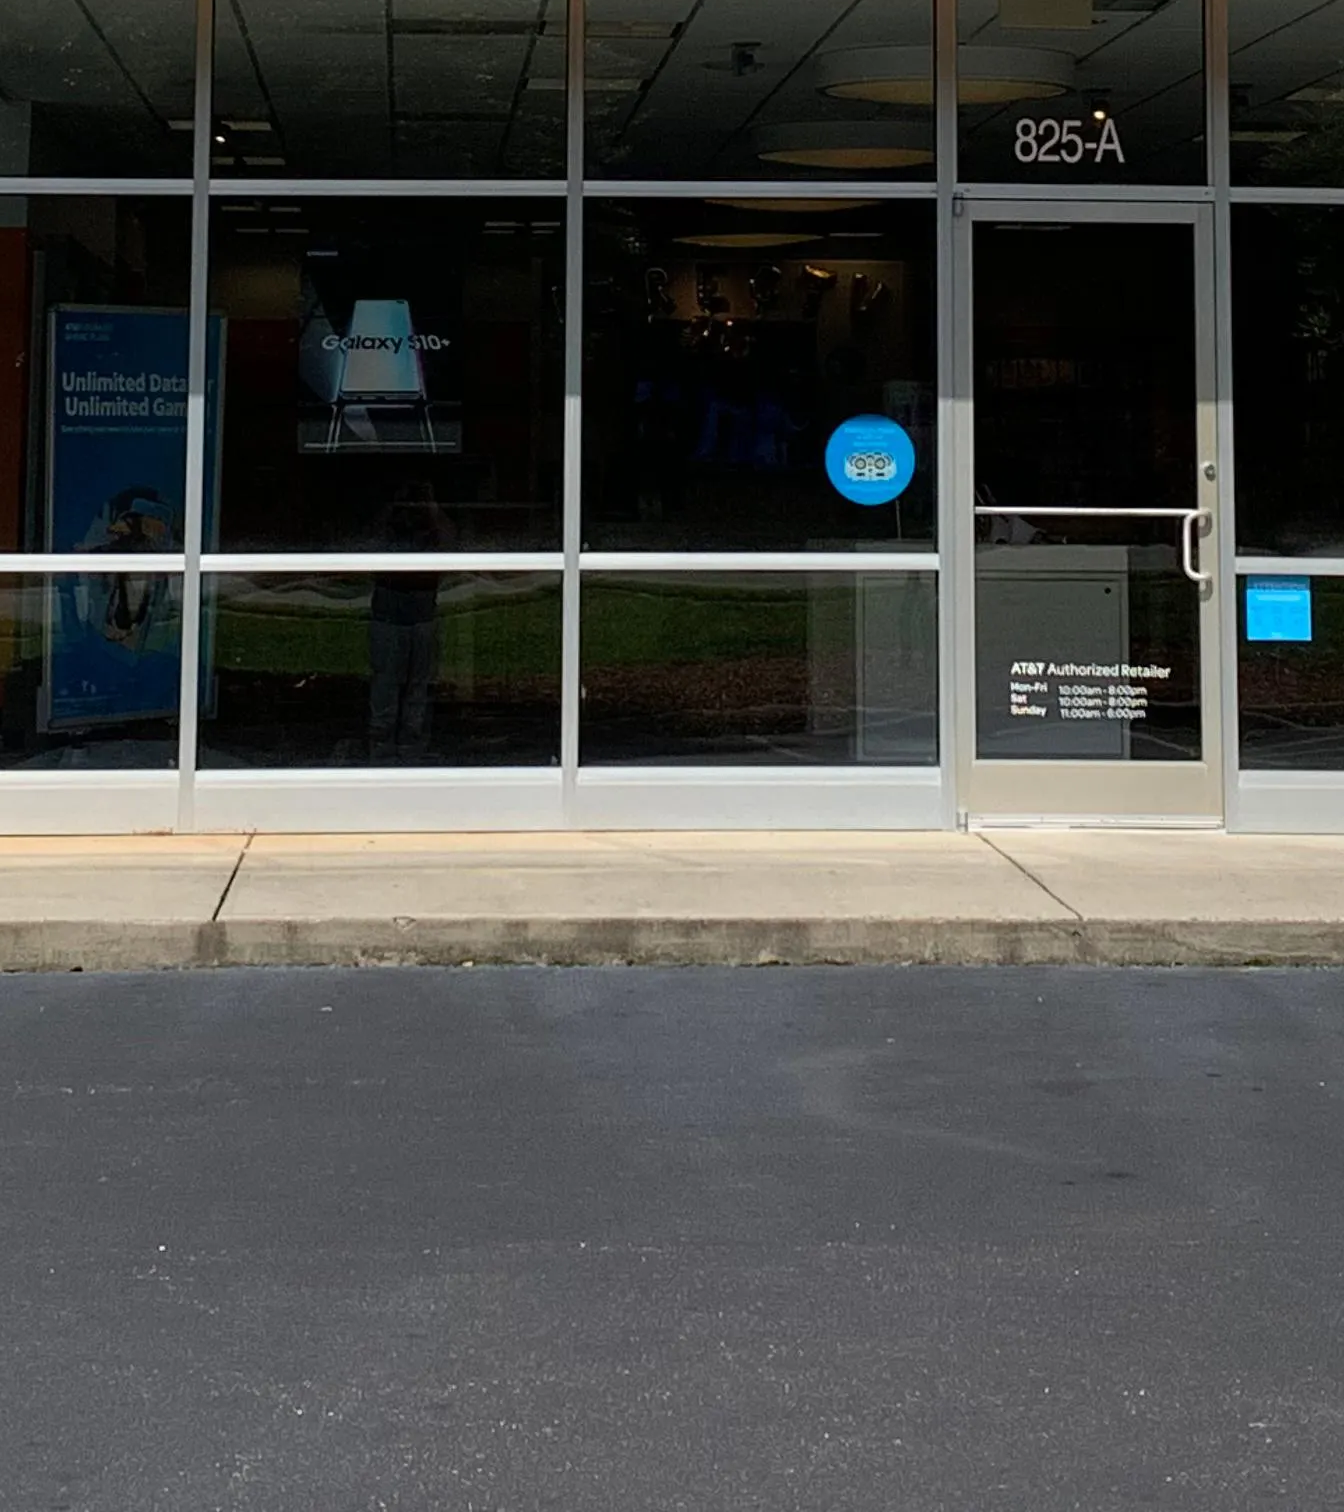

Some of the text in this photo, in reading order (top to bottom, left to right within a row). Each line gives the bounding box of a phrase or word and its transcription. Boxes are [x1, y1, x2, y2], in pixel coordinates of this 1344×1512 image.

[1014, 117, 1125, 164] 825-A
[321, 333, 453, 354] Galaxy S10+
[61, 371, 146, 393] Unlimited
[148, 373, 189, 393] Data
[64, 395, 188, 417] Unlimited Gam
[1010, 662, 1171, 678] AT&T Authorized Retailer
